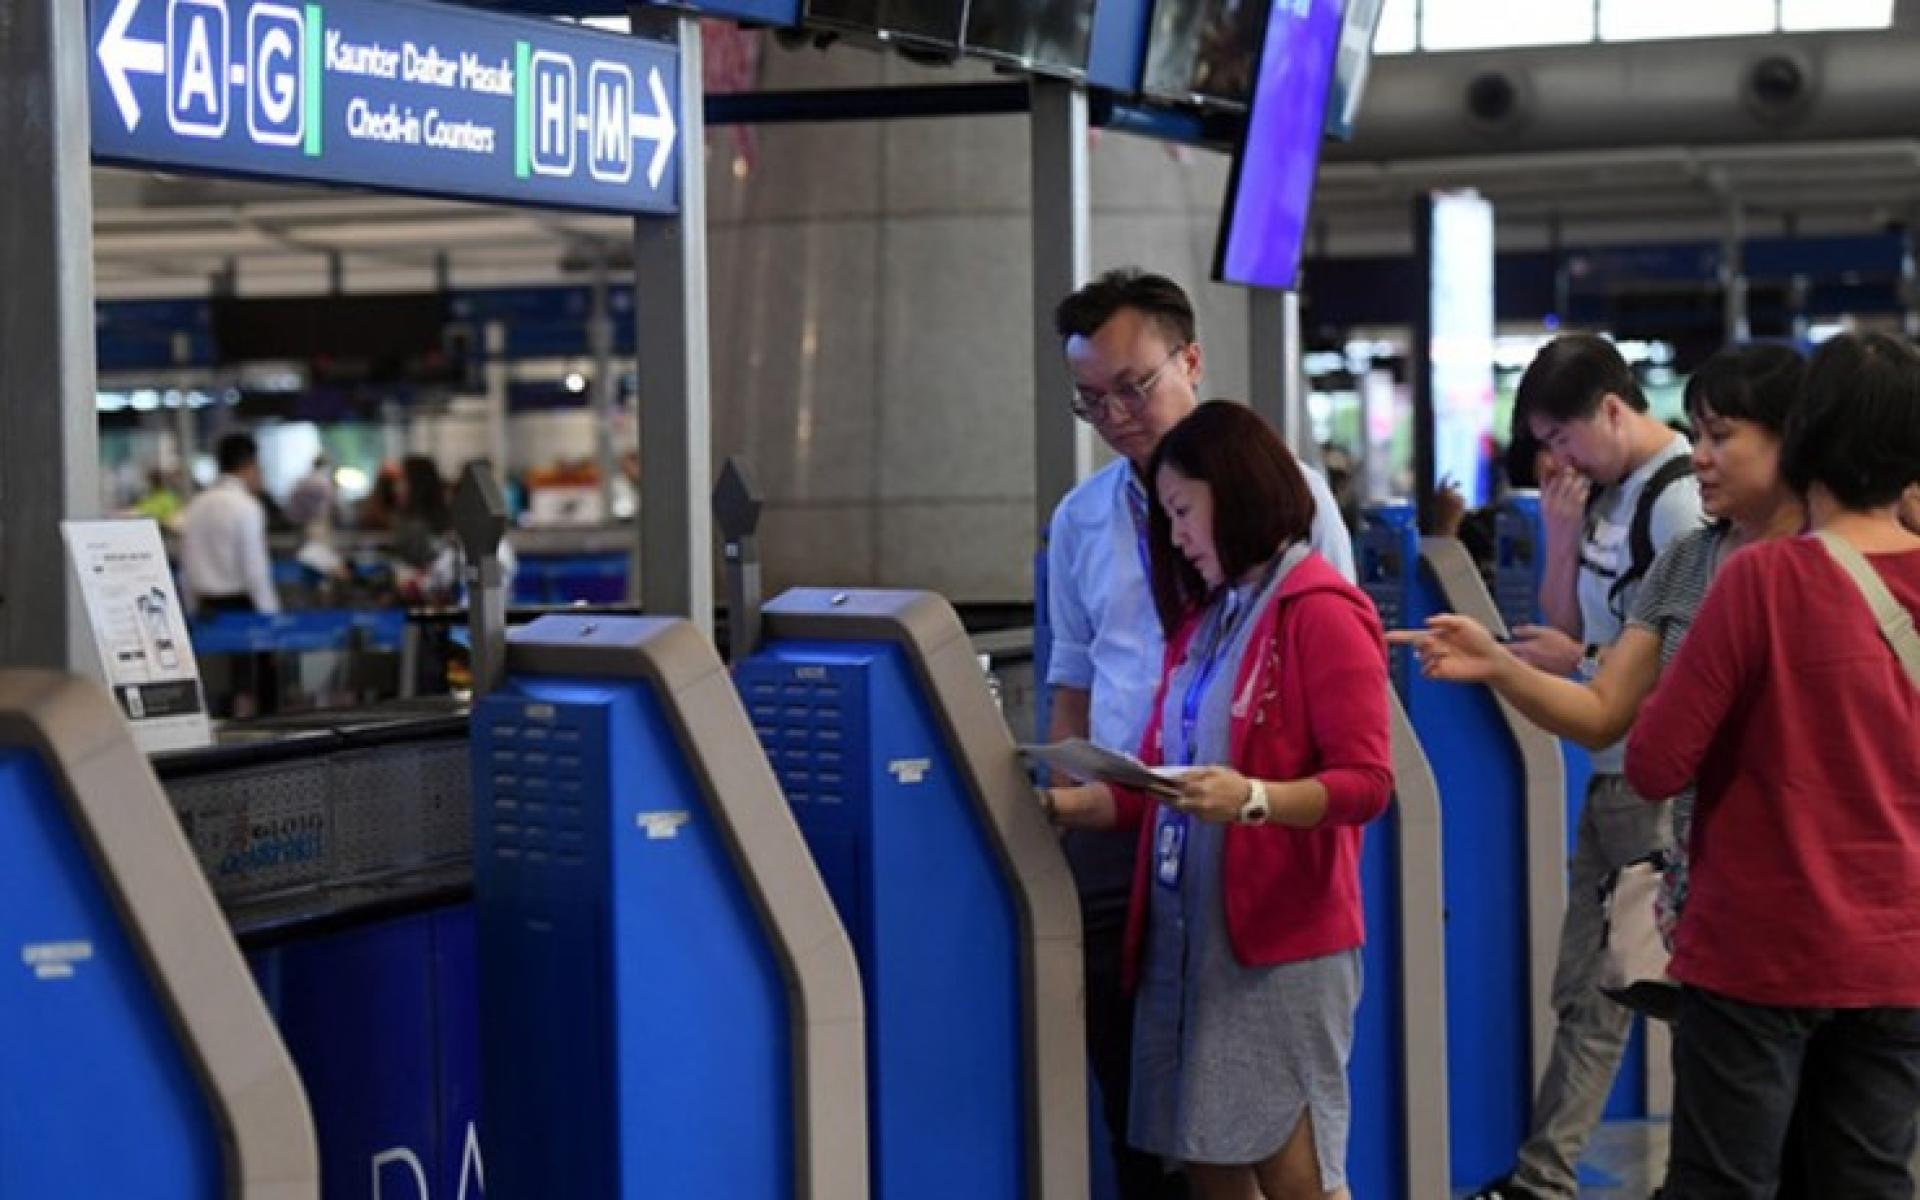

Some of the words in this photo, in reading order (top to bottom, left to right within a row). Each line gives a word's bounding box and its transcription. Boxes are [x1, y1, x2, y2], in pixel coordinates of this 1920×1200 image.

[325, 29, 399, 79] Kaunter
[402, 41, 457, 86] Daftar
[460, 52, 514, 97] Masuk
[347, 98, 420, 144] Check-in
[424, 108, 496, 154] Counters
